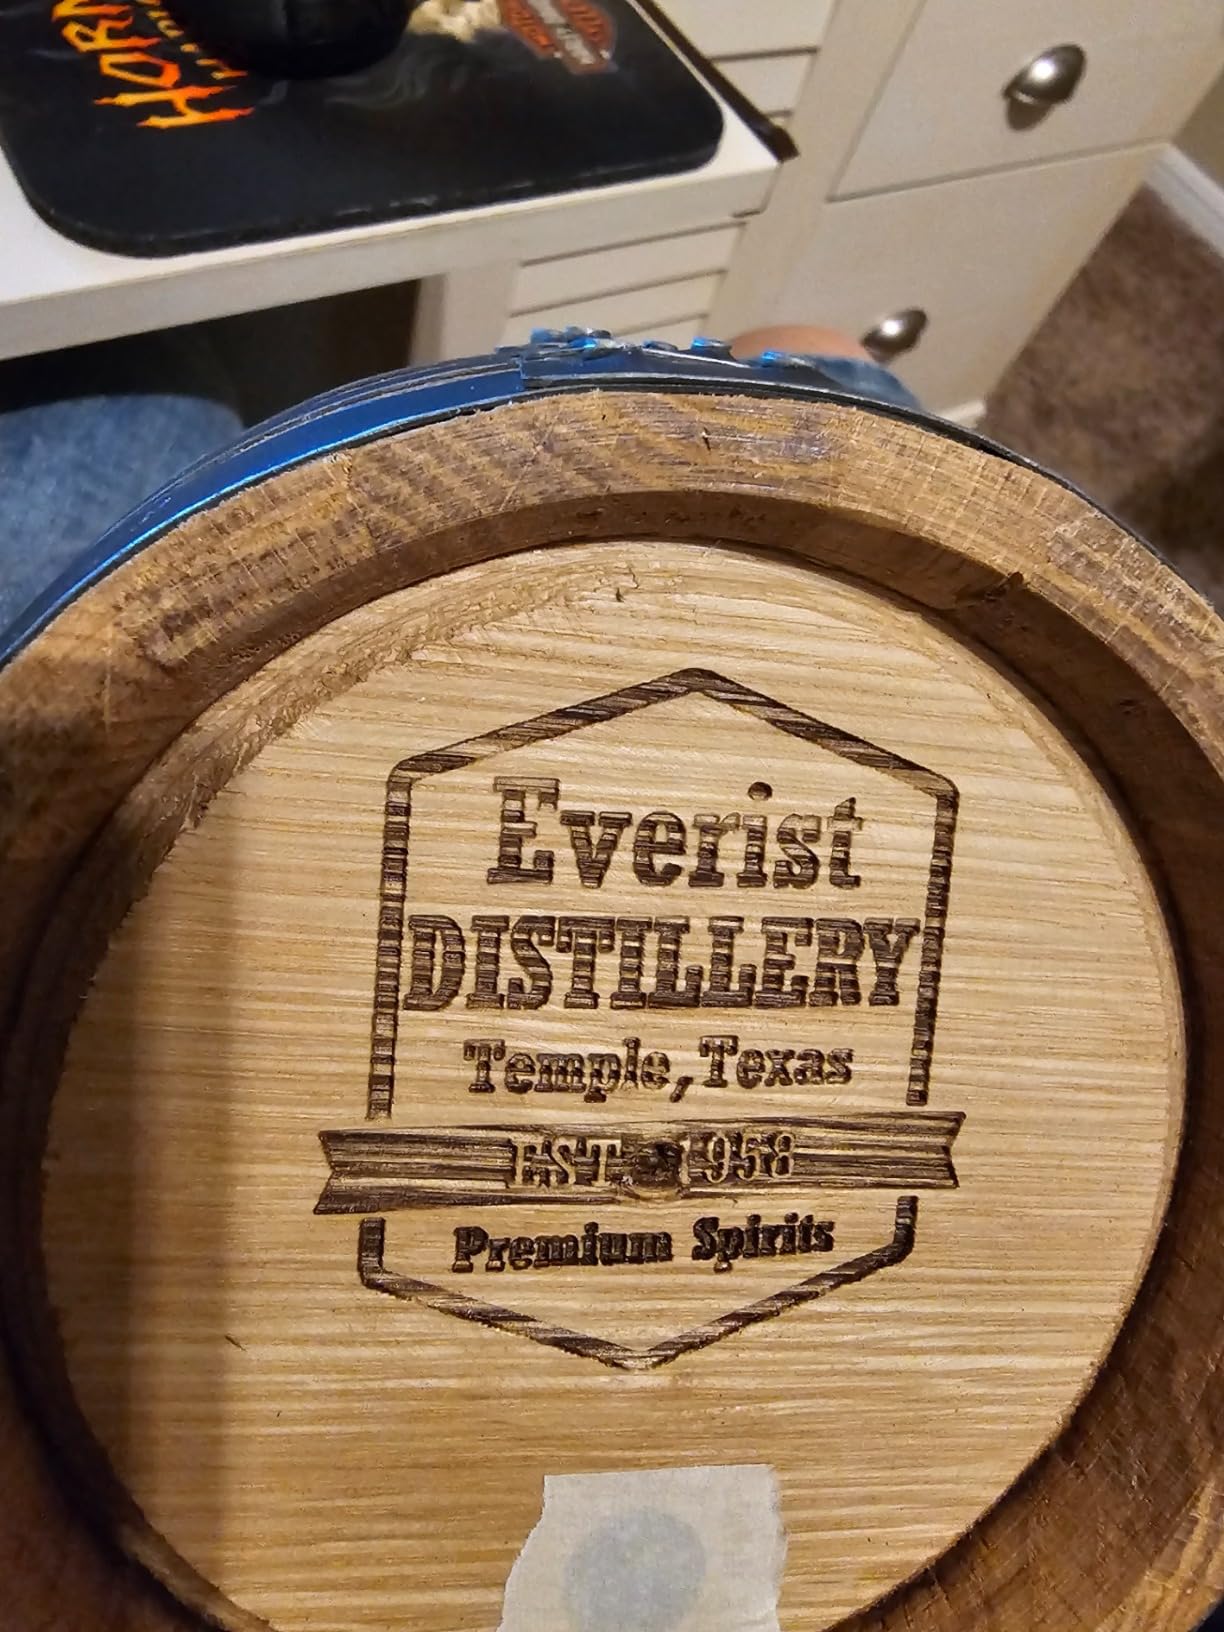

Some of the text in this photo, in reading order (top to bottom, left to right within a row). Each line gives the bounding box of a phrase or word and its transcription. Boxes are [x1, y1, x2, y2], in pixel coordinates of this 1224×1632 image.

[486, 776, 862, 889] Everist
[402, 914, 921, 1011] DISTILLERY
[463, 1035, 854, 1103] Temple, Texas
[508, 1135, 623, 1188] EST
[452, 1212, 835, 1273] Premium Spirits
